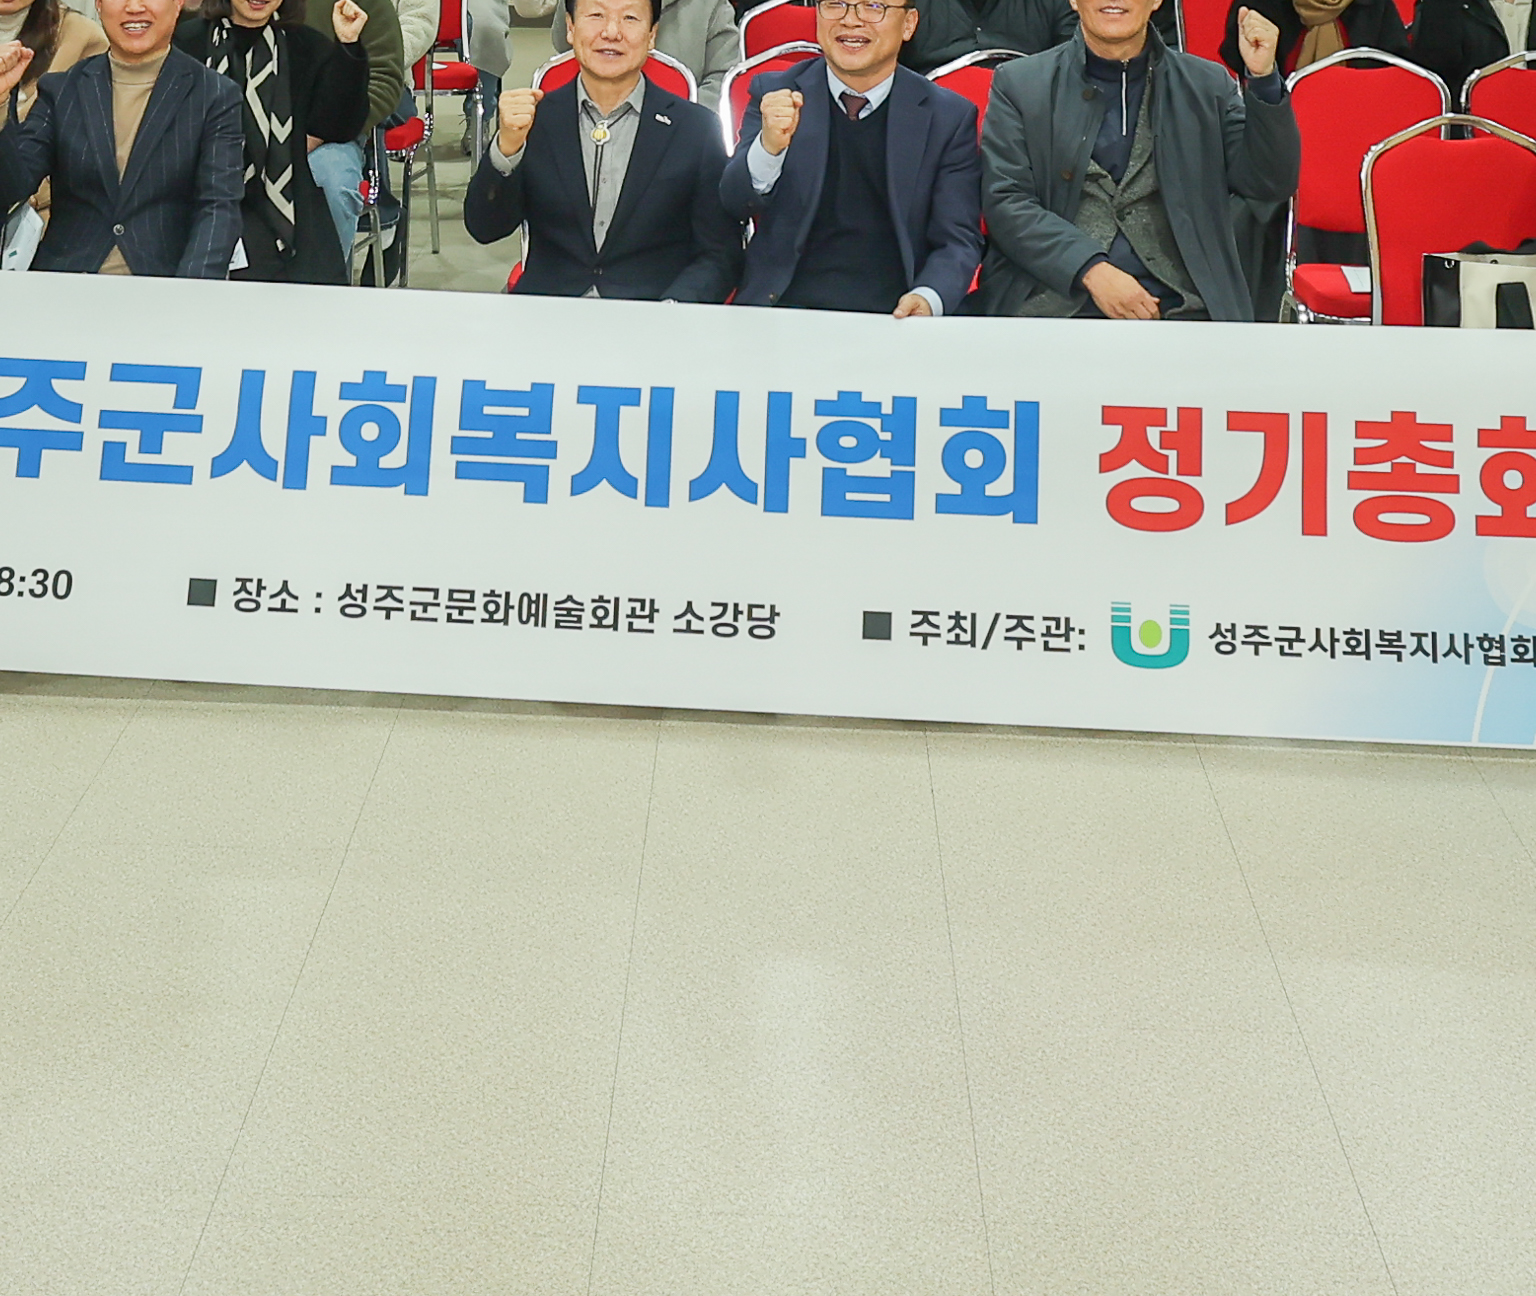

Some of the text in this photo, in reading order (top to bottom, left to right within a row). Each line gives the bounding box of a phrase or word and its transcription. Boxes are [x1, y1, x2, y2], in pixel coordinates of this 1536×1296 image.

[232, 576, 300, 615] 장소
[337, 582, 661, 635] 성주군문화예술회관
[672, 600, 782, 641] 소강당
[909, 609, 1086, 653] 주최/주관:
